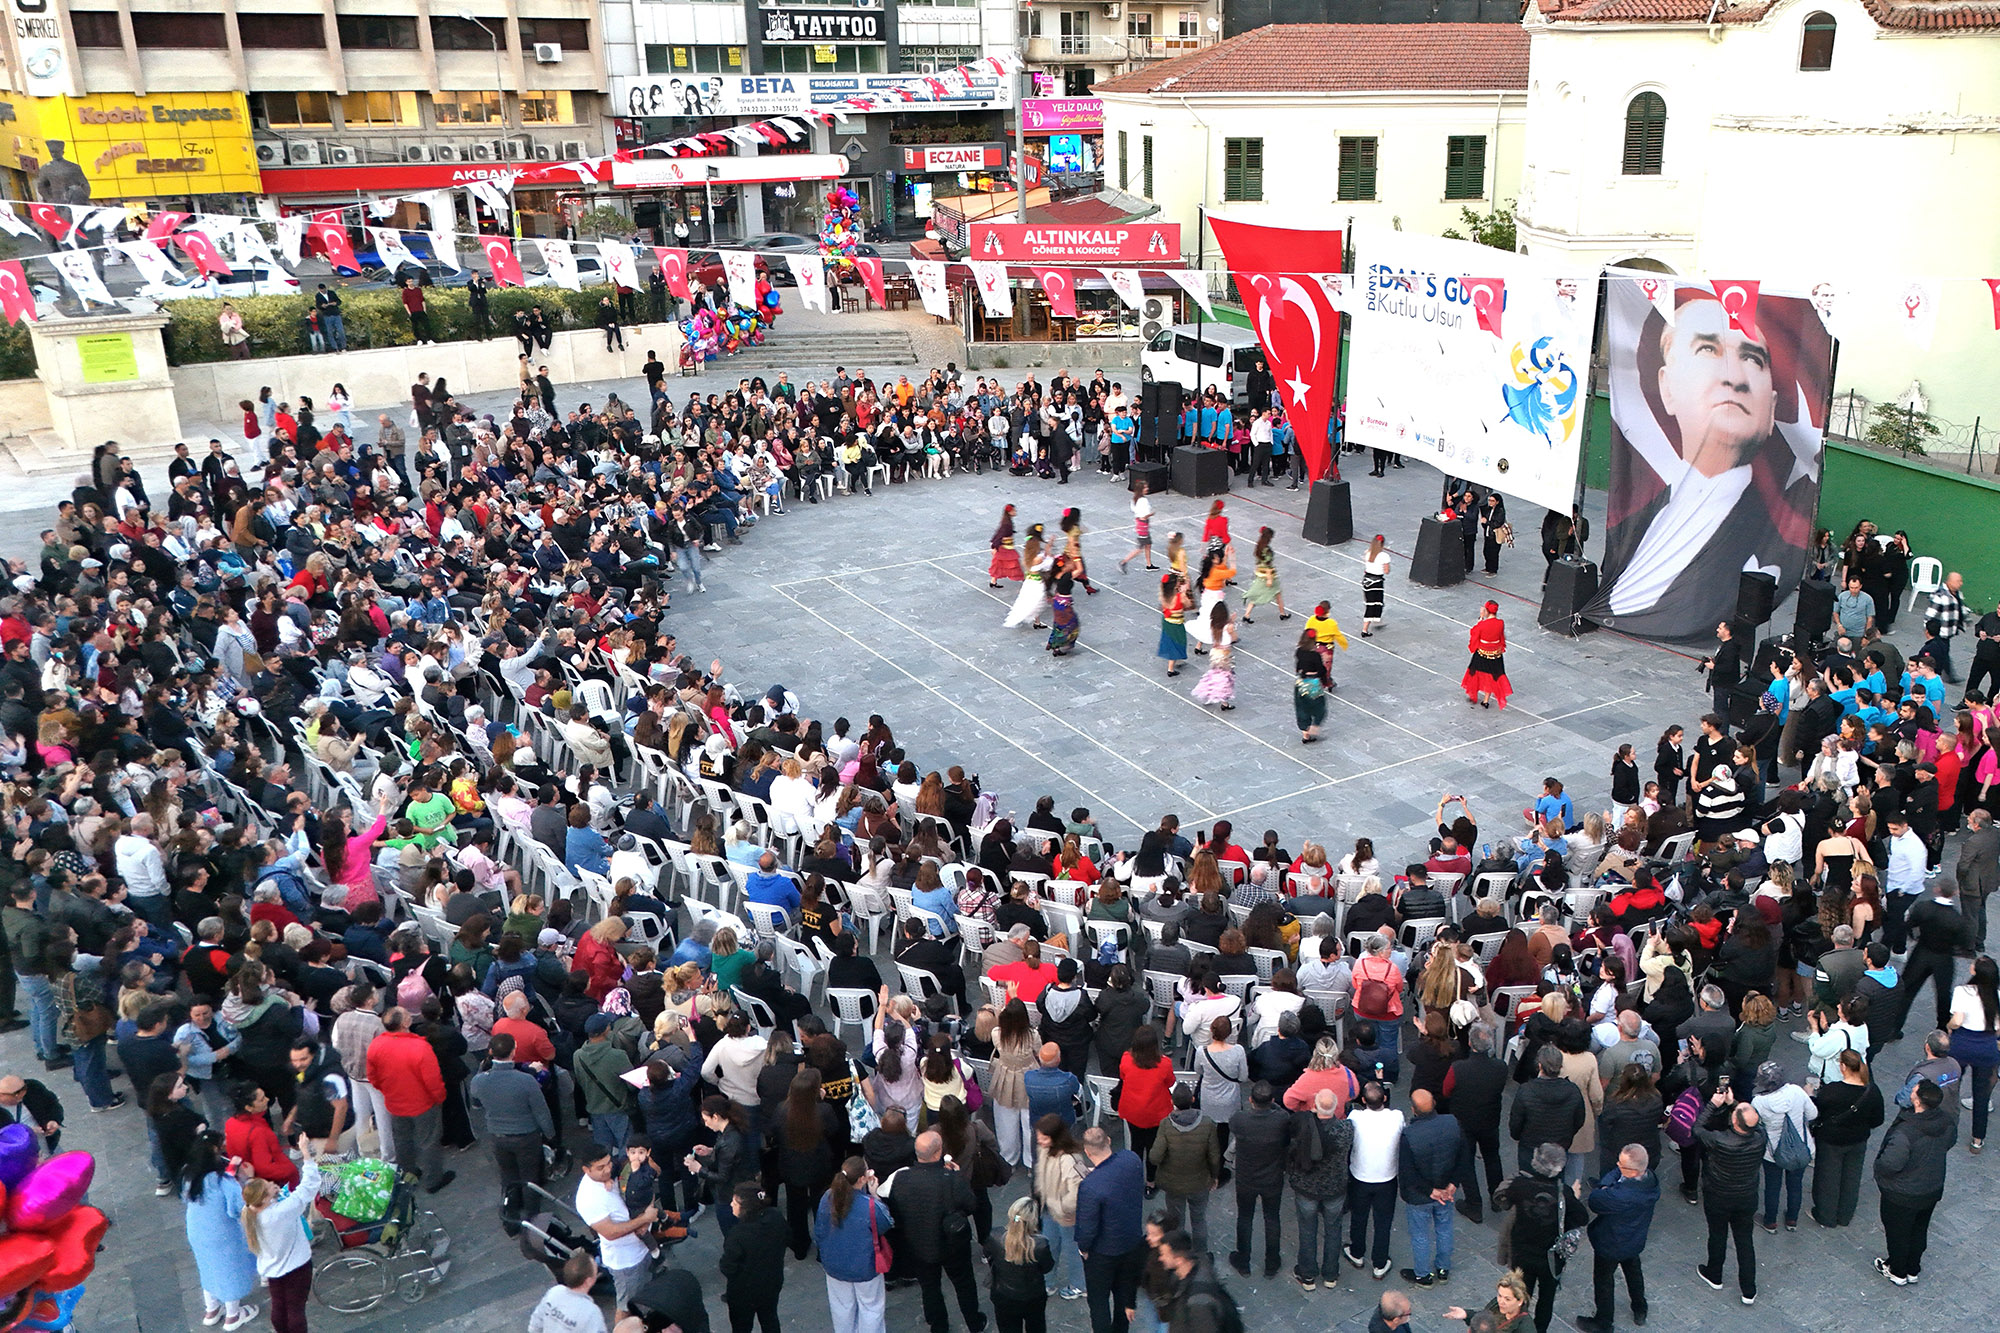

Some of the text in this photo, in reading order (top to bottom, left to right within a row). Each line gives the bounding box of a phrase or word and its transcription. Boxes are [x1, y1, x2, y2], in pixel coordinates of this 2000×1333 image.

[794, 16, 877, 37] TATTOO
[740, 78, 796, 94] BETA
[1052, 101, 1075, 112] YELİZ
[77, 104, 234, 127] Kodak Express
[183, 142, 214, 157] Foto
[929, 149, 981, 164] ECZANE
[1023, 230, 1129, 245] ALTINKALP
[1032, 245, 1120, 256] DÖNER & KOKOREÇ
[1380, 264, 1437, 298] DAS
[1378, 292, 1418, 319] Kutlu
